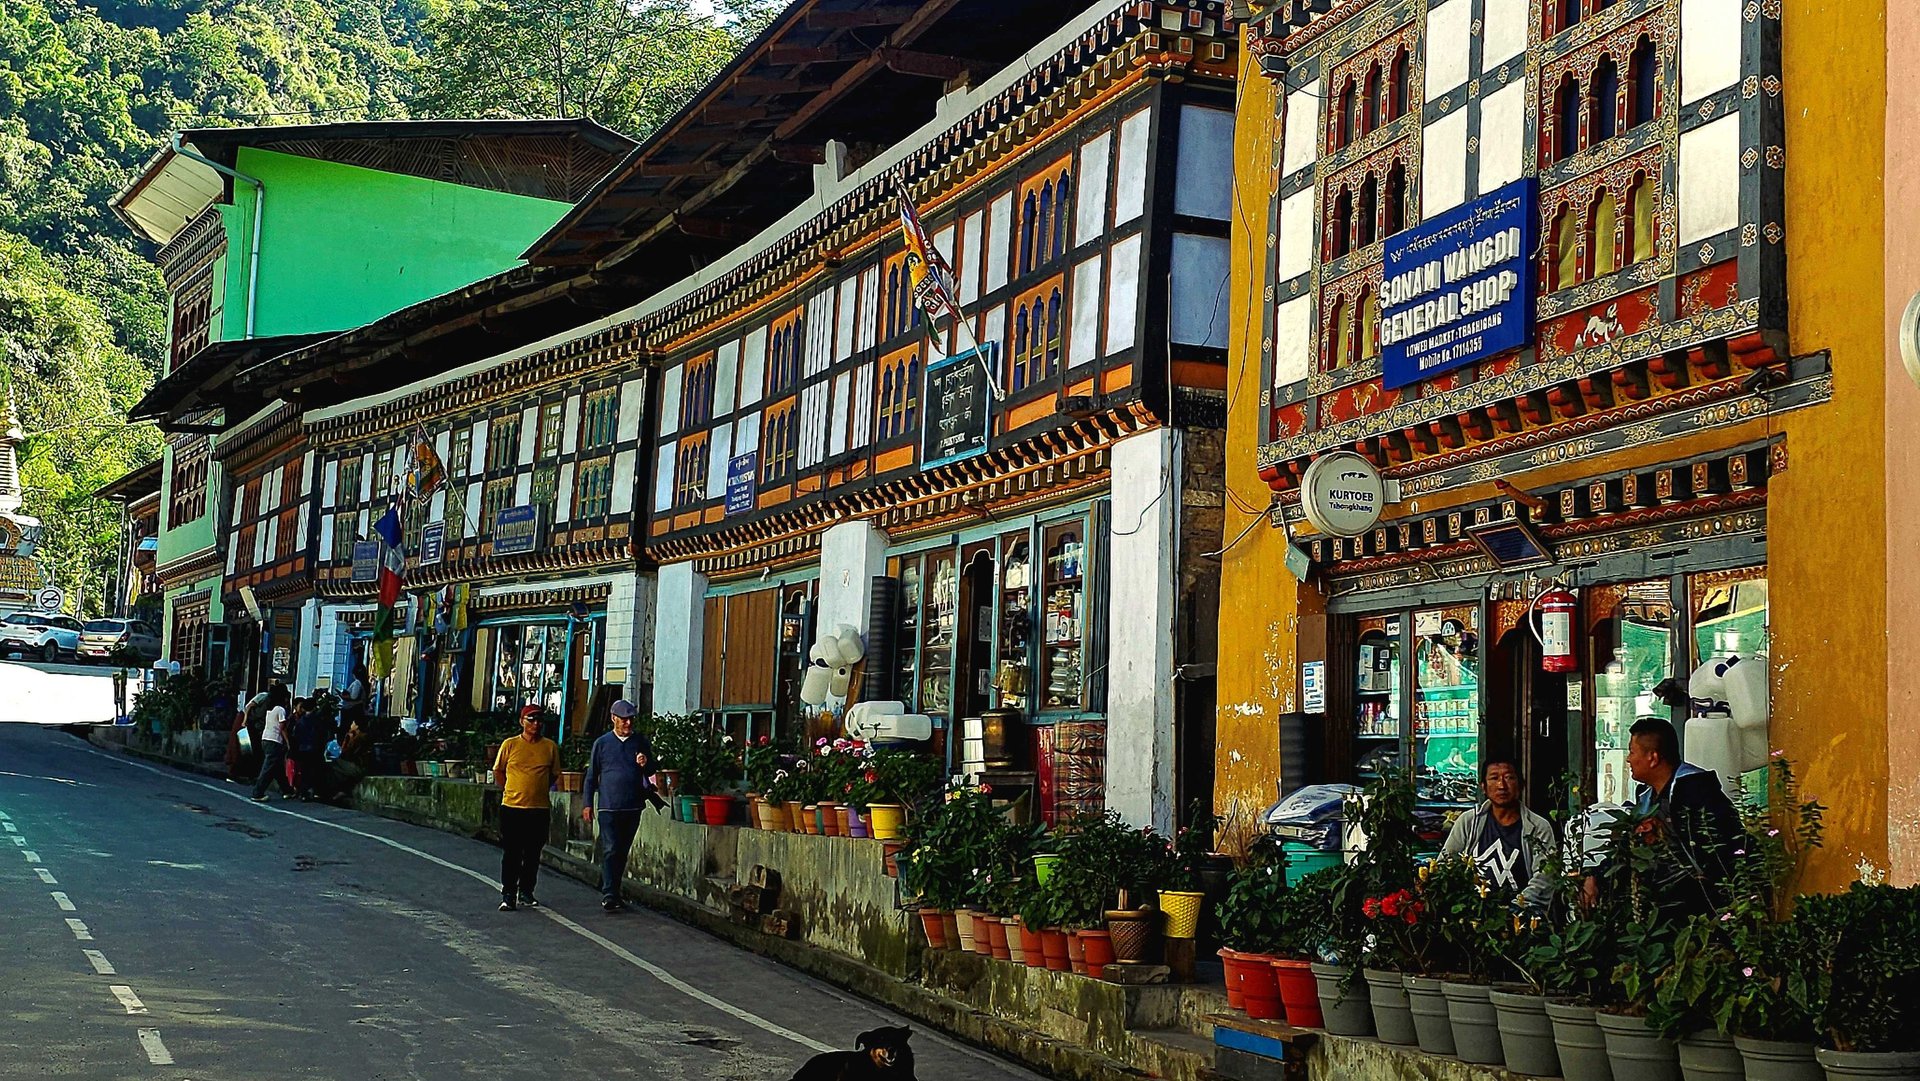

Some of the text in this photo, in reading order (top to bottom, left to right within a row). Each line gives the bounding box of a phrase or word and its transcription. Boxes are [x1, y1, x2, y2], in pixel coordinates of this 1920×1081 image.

[1380, 260, 1441, 309] SONAM
[1443, 227, 1521, 283] WANGDI
[1381, 269, 1518, 346] GENERAL SHOP
[1419, 353, 1441, 371] Mobile
[1329, 490, 1374, 501] KURTOEB
